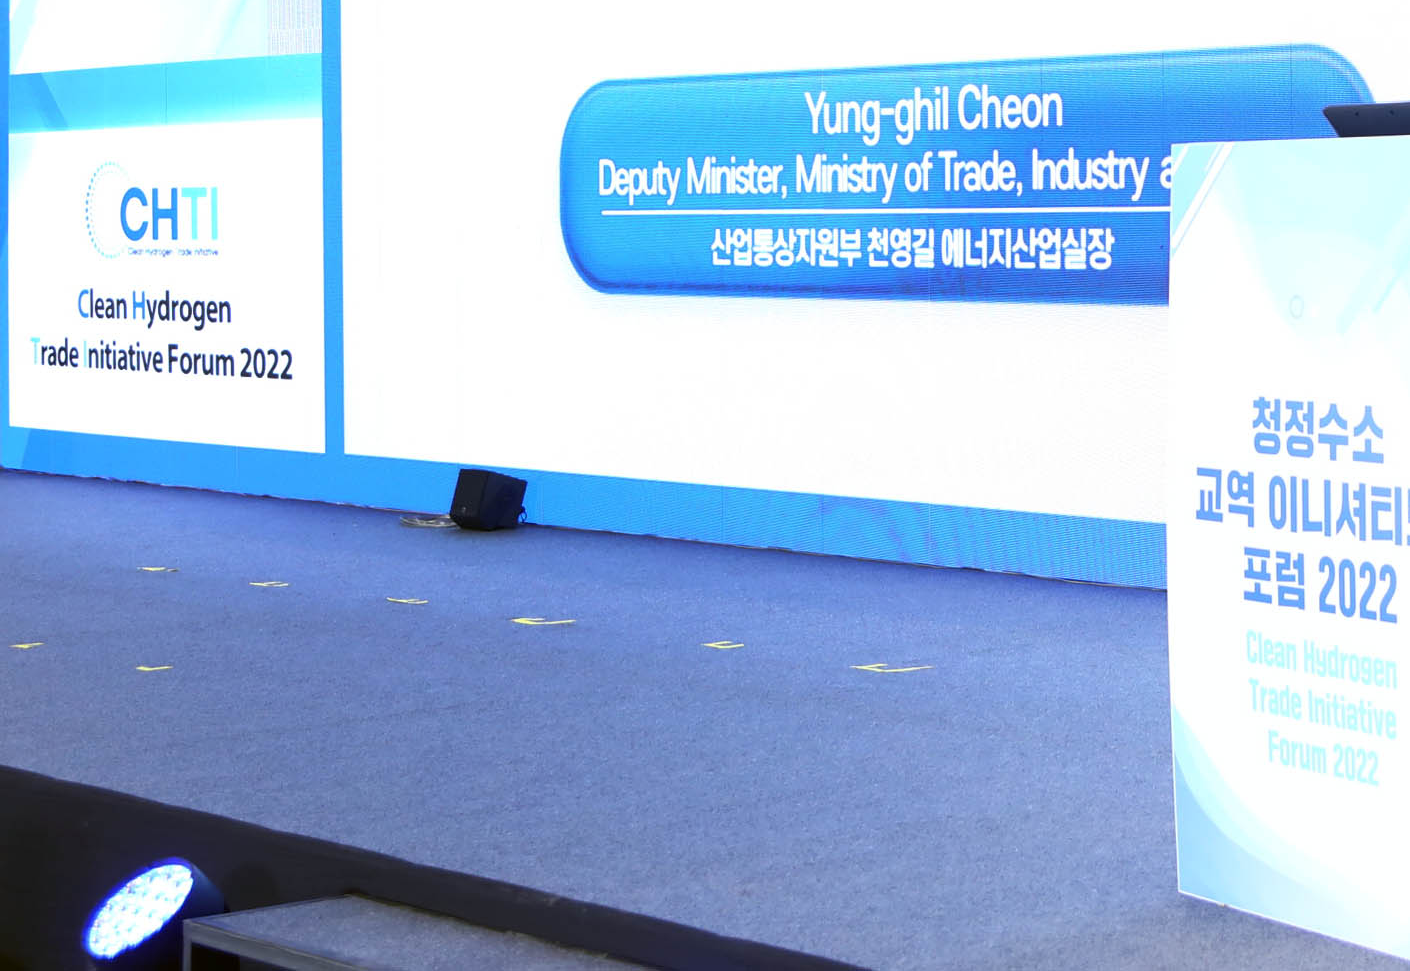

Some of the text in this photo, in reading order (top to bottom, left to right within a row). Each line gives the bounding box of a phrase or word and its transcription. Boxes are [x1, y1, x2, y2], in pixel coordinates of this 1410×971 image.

[803, 83, 1064, 144] Yung-ghil Cheon
[598, 158, 682, 206] Deputy
[686, 156, 789, 200] Minister,
[795, 152, 899, 204] Ministry
[903, 152, 935, 193] of
[939, 149, 1024, 196] Trade,
[1031, 148, 1151, 203] Industry
[120, 186, 219, 242] CHTI
[710, 226, 1115, 272] 산업통상자원부 천영길 에너지산업실장
[78, 287, 232, 331] Clean Hydrogen
[30, 336, 293, 380] Trade Initiative Forum 2022
[1252, 396, 1384, 464] 청정수소
[1195, 466, 1255, 528] 교역
[1243, 546, 1398, 623] 포럼 2022
[1245, 630, 1398, 689] Clean Hydrogen
[1249, 678, 1398, 740] Trade Initiative
[1268, 729, 1380, 787] Forum 2022
